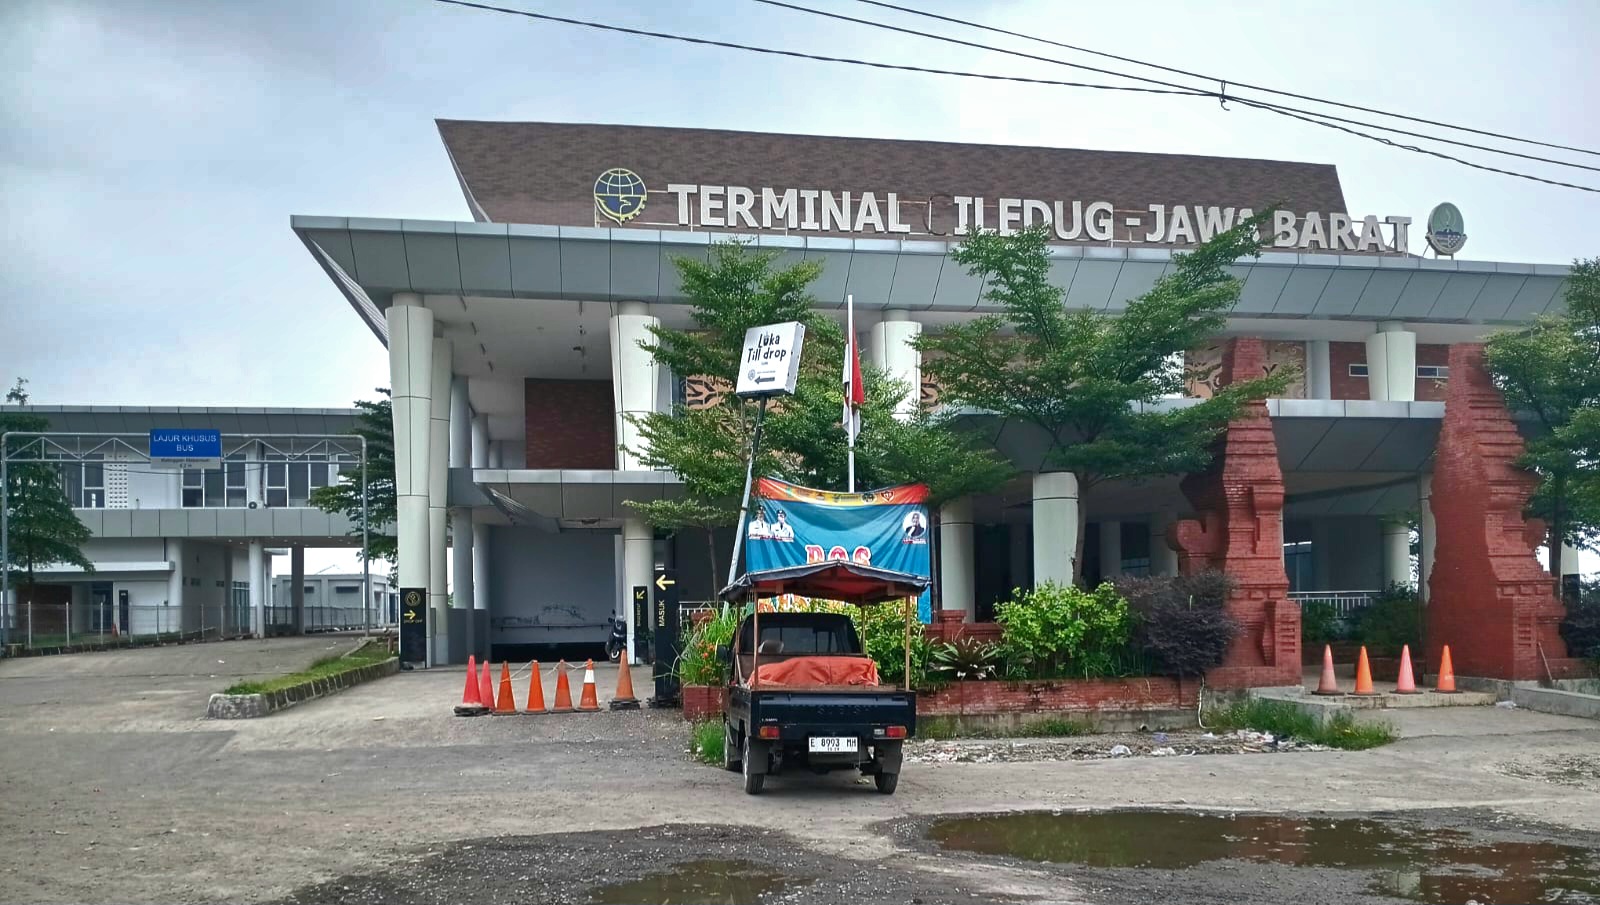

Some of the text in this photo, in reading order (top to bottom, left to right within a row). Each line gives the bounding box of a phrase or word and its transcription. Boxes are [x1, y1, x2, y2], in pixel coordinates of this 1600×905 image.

[667, 183, 911, 233] TERMINAL
[1126, 217, 1140, 226] -
[1273, 209, 1412, 253] BARAT
[758, 332, 781, 349] Luka
[747, 347, 787, 363] Till drop
[153, 434, 217, 442] LAJUR KHUSUS
[176, 444, 194, 452] BUS
[810, 738, 857, 747] E 8993 MH
